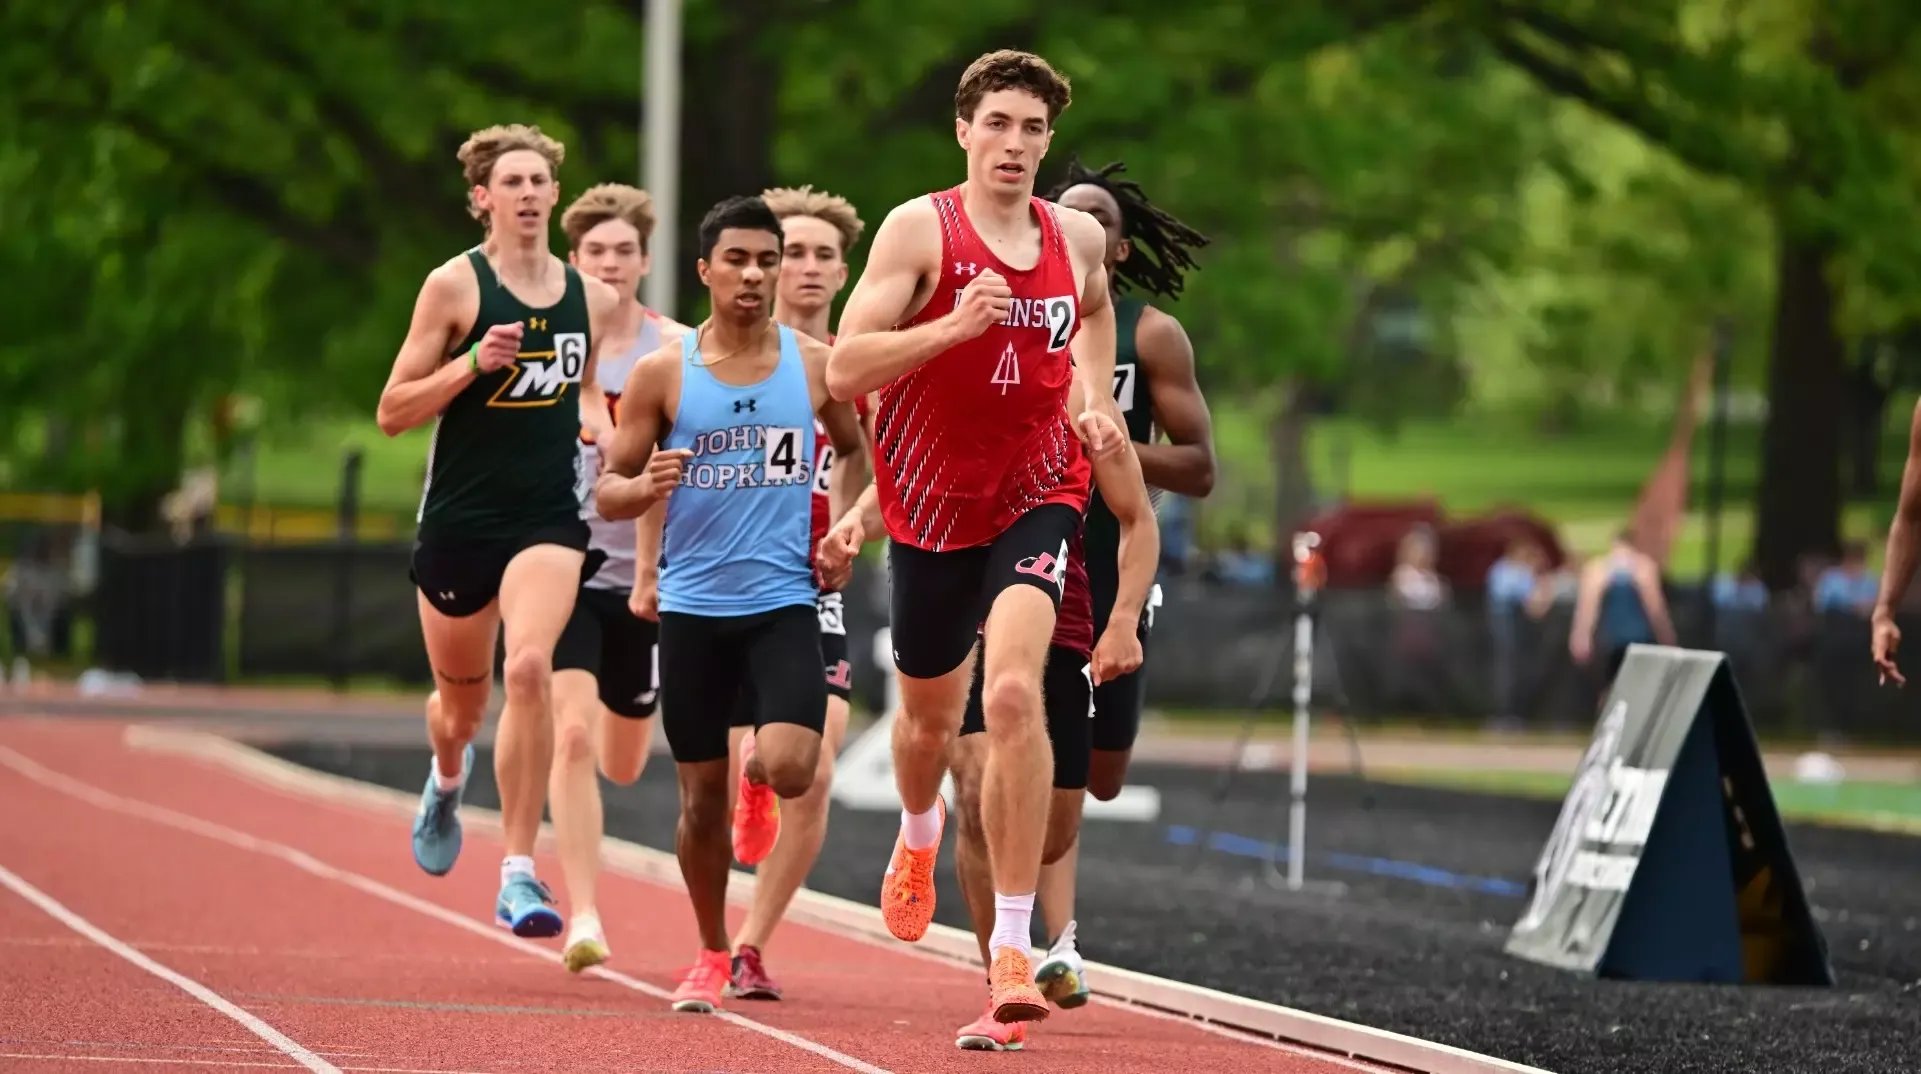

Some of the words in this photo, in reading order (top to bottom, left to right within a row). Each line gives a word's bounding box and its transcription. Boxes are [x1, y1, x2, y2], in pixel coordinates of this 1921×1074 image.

[1051, 300, 1071, 349] 2
[561, 337, 581, 379] 6
[1112, 369, 1129, 404] 7
[770, 432, 796, 475] 4
